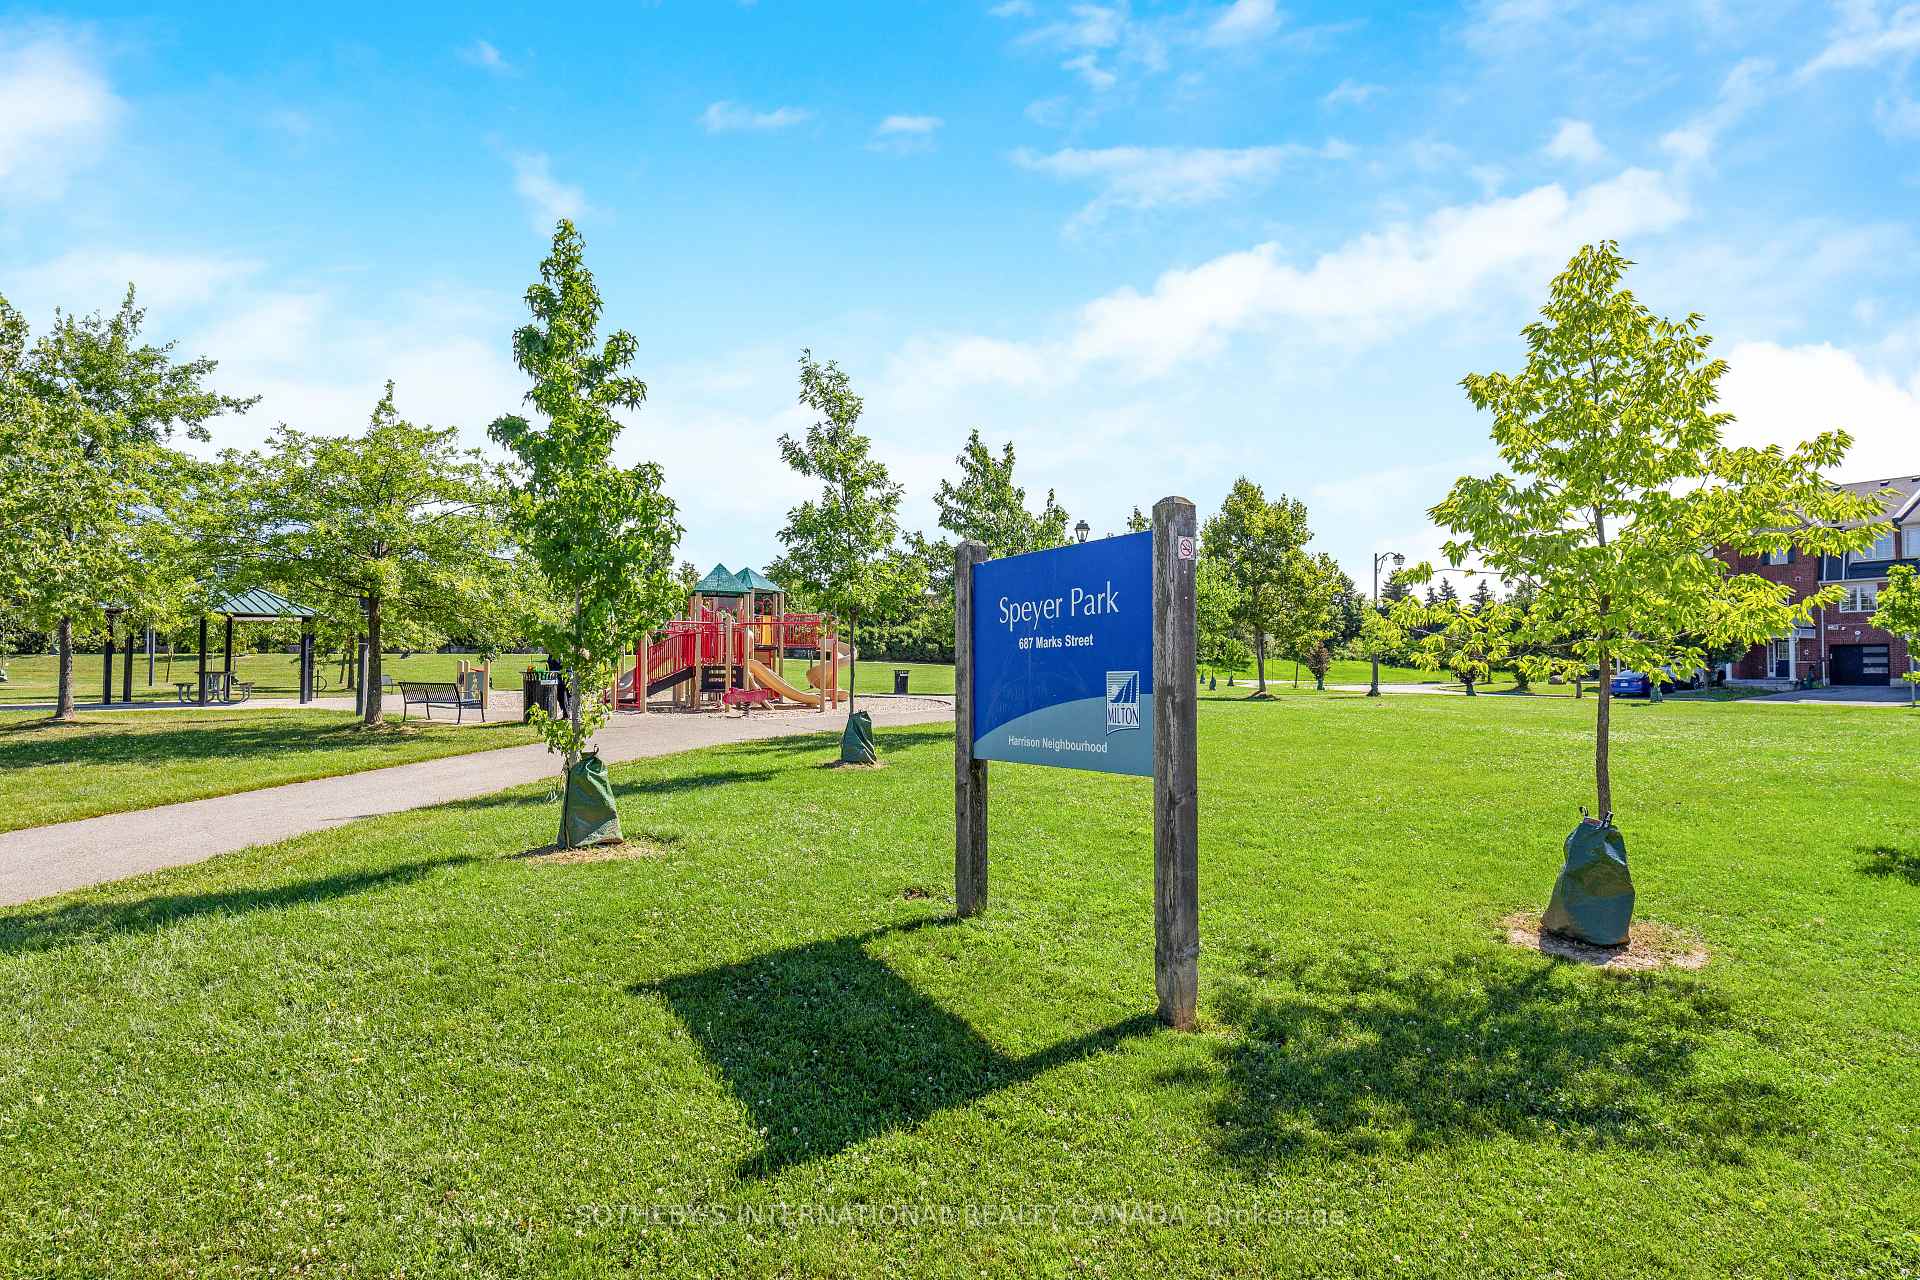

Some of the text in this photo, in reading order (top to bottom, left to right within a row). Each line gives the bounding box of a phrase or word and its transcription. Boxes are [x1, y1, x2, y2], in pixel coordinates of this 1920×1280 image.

[999, 580, 1119, 632] Speyer Park
[1018, 633, 1094, 650] 687 Marks Street
[1107, 706, 1139, 725] MILTON
[1008, 735, 1108, 753] Harrison Neighbourhood
